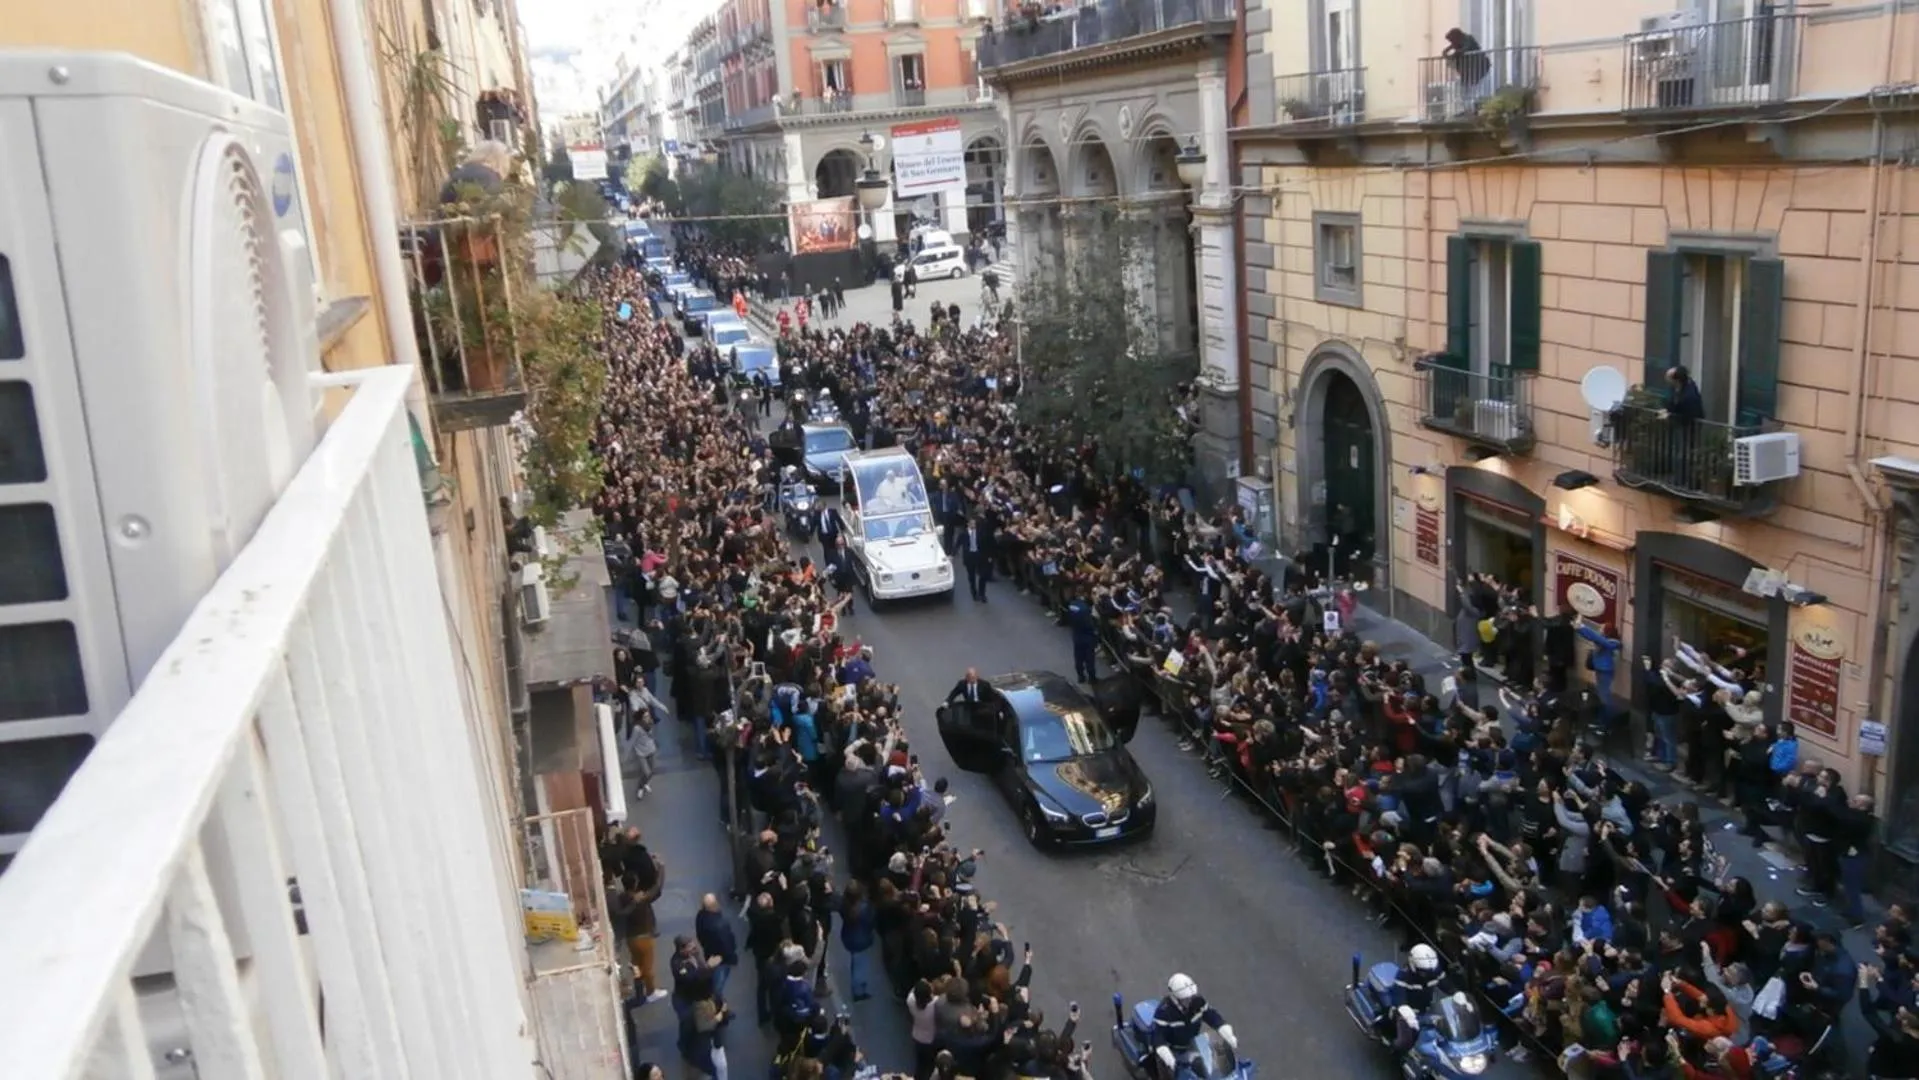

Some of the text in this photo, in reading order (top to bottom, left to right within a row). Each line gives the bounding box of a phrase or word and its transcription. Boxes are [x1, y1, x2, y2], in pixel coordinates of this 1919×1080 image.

[896, 159, 922, 169] Museo
[924, 155, 936, 168] del
[901, 165, 961, 178] di San Gennaro
[1583, 566, 1617, 597] DUOMO
